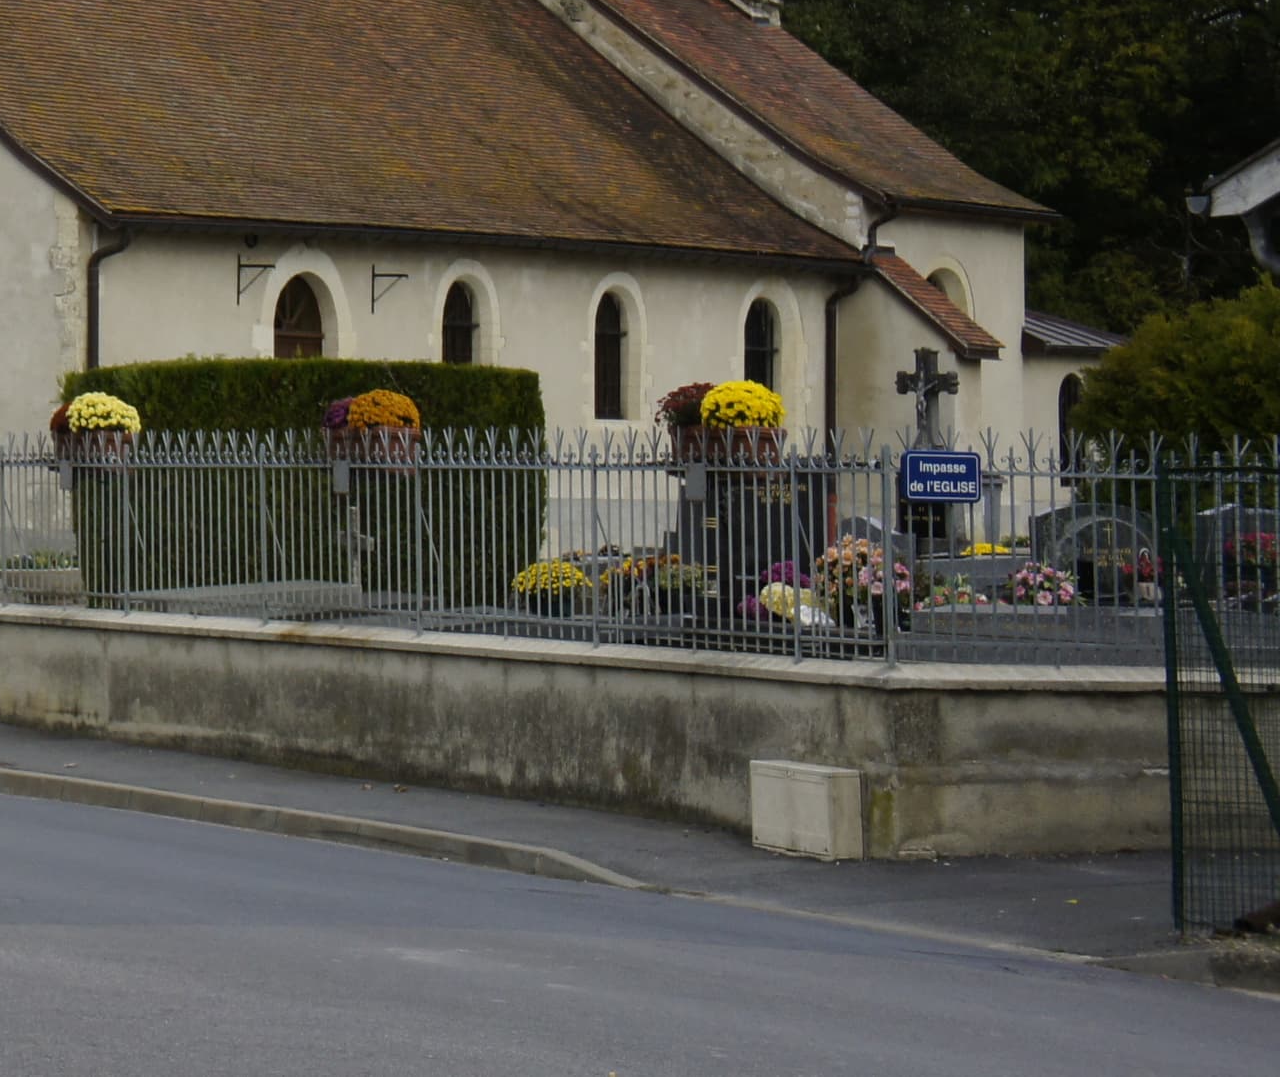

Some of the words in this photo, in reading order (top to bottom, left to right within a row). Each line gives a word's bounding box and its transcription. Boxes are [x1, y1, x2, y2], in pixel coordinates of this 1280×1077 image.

[920, 460, 966, 475] Impasse
[910, 480, 924, 492] de
[927, 480, 976, 493] l'EGLISE
